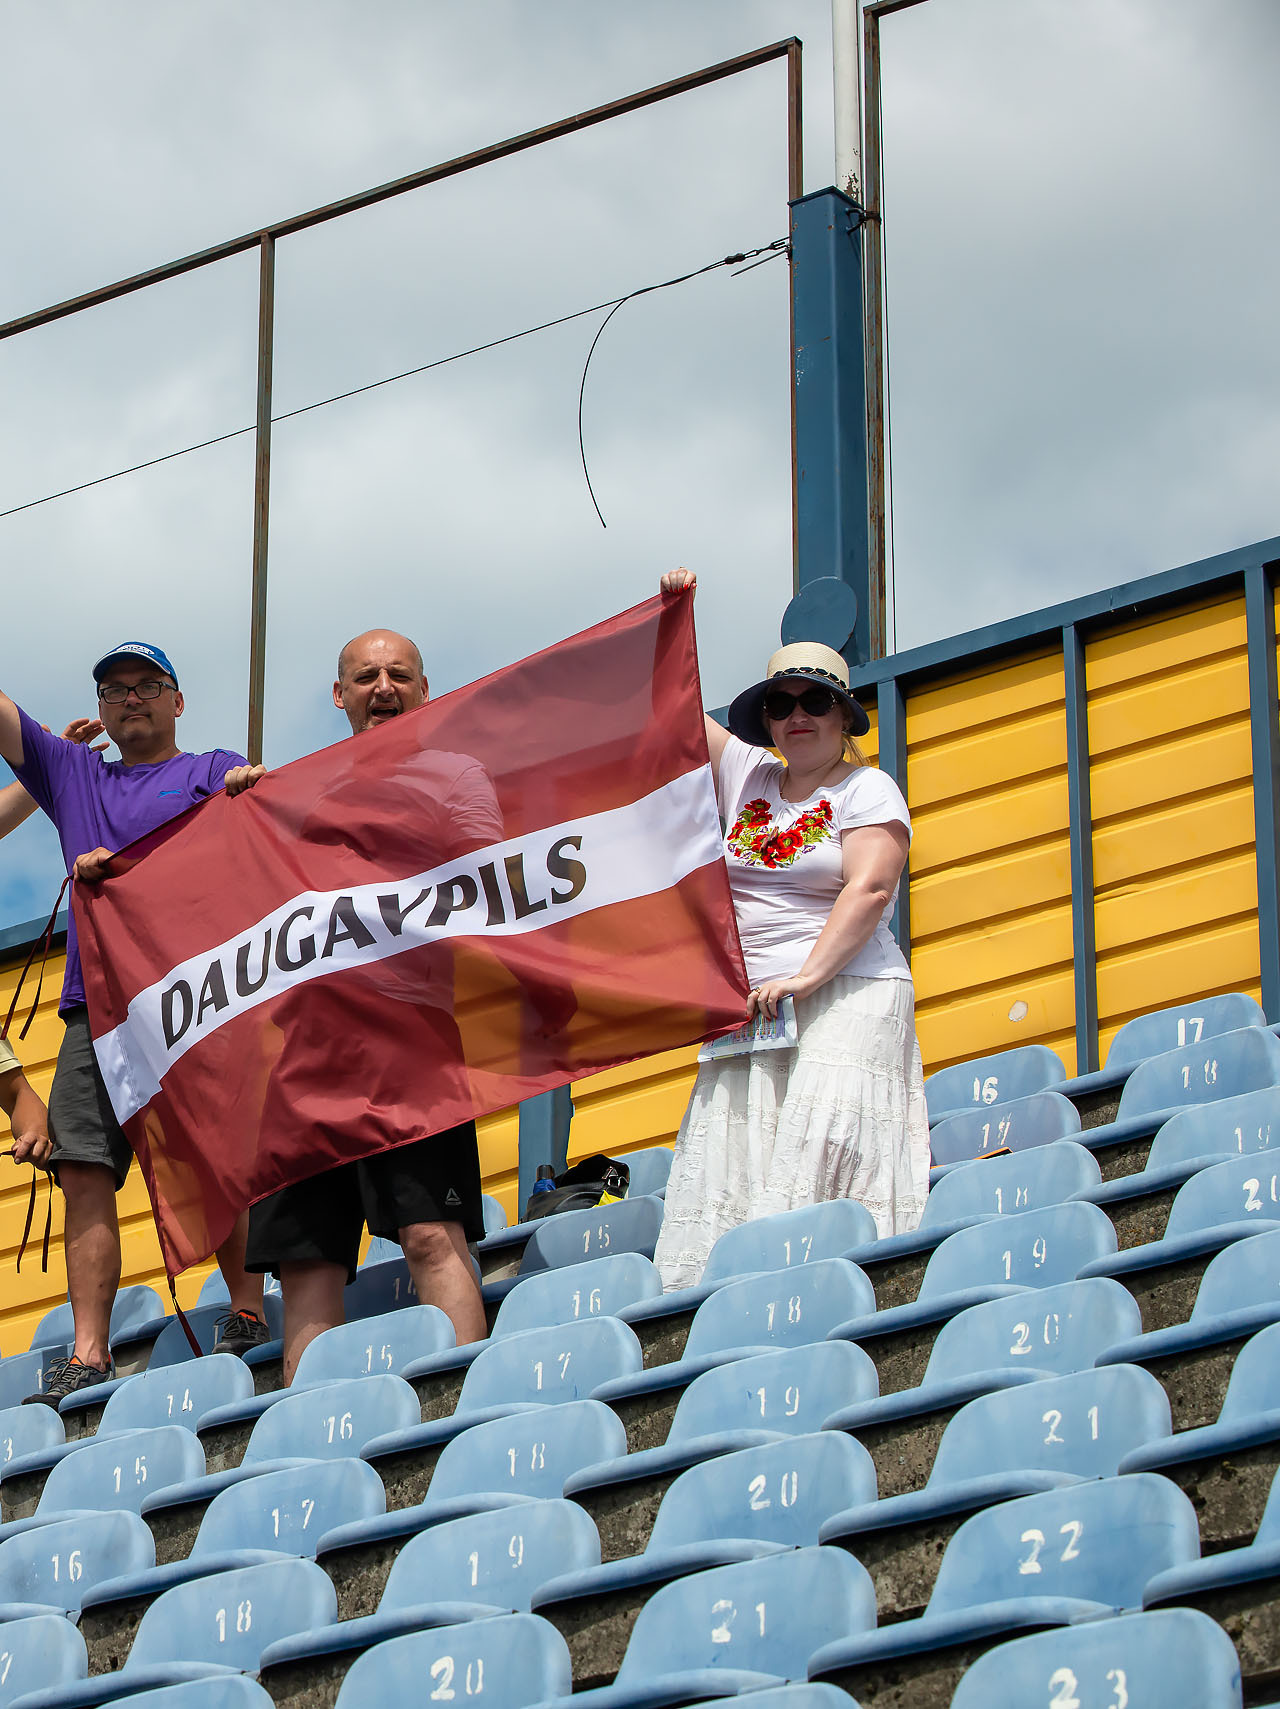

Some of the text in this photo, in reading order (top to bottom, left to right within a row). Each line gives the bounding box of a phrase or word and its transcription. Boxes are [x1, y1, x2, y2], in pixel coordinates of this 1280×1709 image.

[161, 835, 588, 1051] DAUGAVPILS
[1178, 1018, 1205, 1046] 17
[973, 1077, 998, 1104] 16
[583, 1225, 610, 1253] 15
[783, 1235, 813, 1266] 17
[1001, 1236, 1047, 1280] 19
[766, 1295, 801, 1331] 18
[1010, 1313, 1059, 1355] 20
[365, 1344, 393, 1373] 15
[534, 1353, 571, 1390] 17
[168, 1389, 193, 1417] 14
[756, 1387, 800, 1417] 19
[324, 1412, 353, 1443] 16
[1041, 1406, 1098, 1444] 21
[113, 1456, 147, 1494] 15
[508, 1442, 544, 1476] 18
[748, 1472, 798, 1510] 20
[271, 1499, 315, 1537] 17
[52, 1551, 83, 1582] 16
[469, 1535, 523, 1586] 19
[1019, 1520, 1084, 1575] 22
[215, 1600, 251, 1642] 18
[711, 1599, 767, 1643] 21
[430, 1656, 484, 1700] 20
[1049, 1667, 1128, 1709] 23
